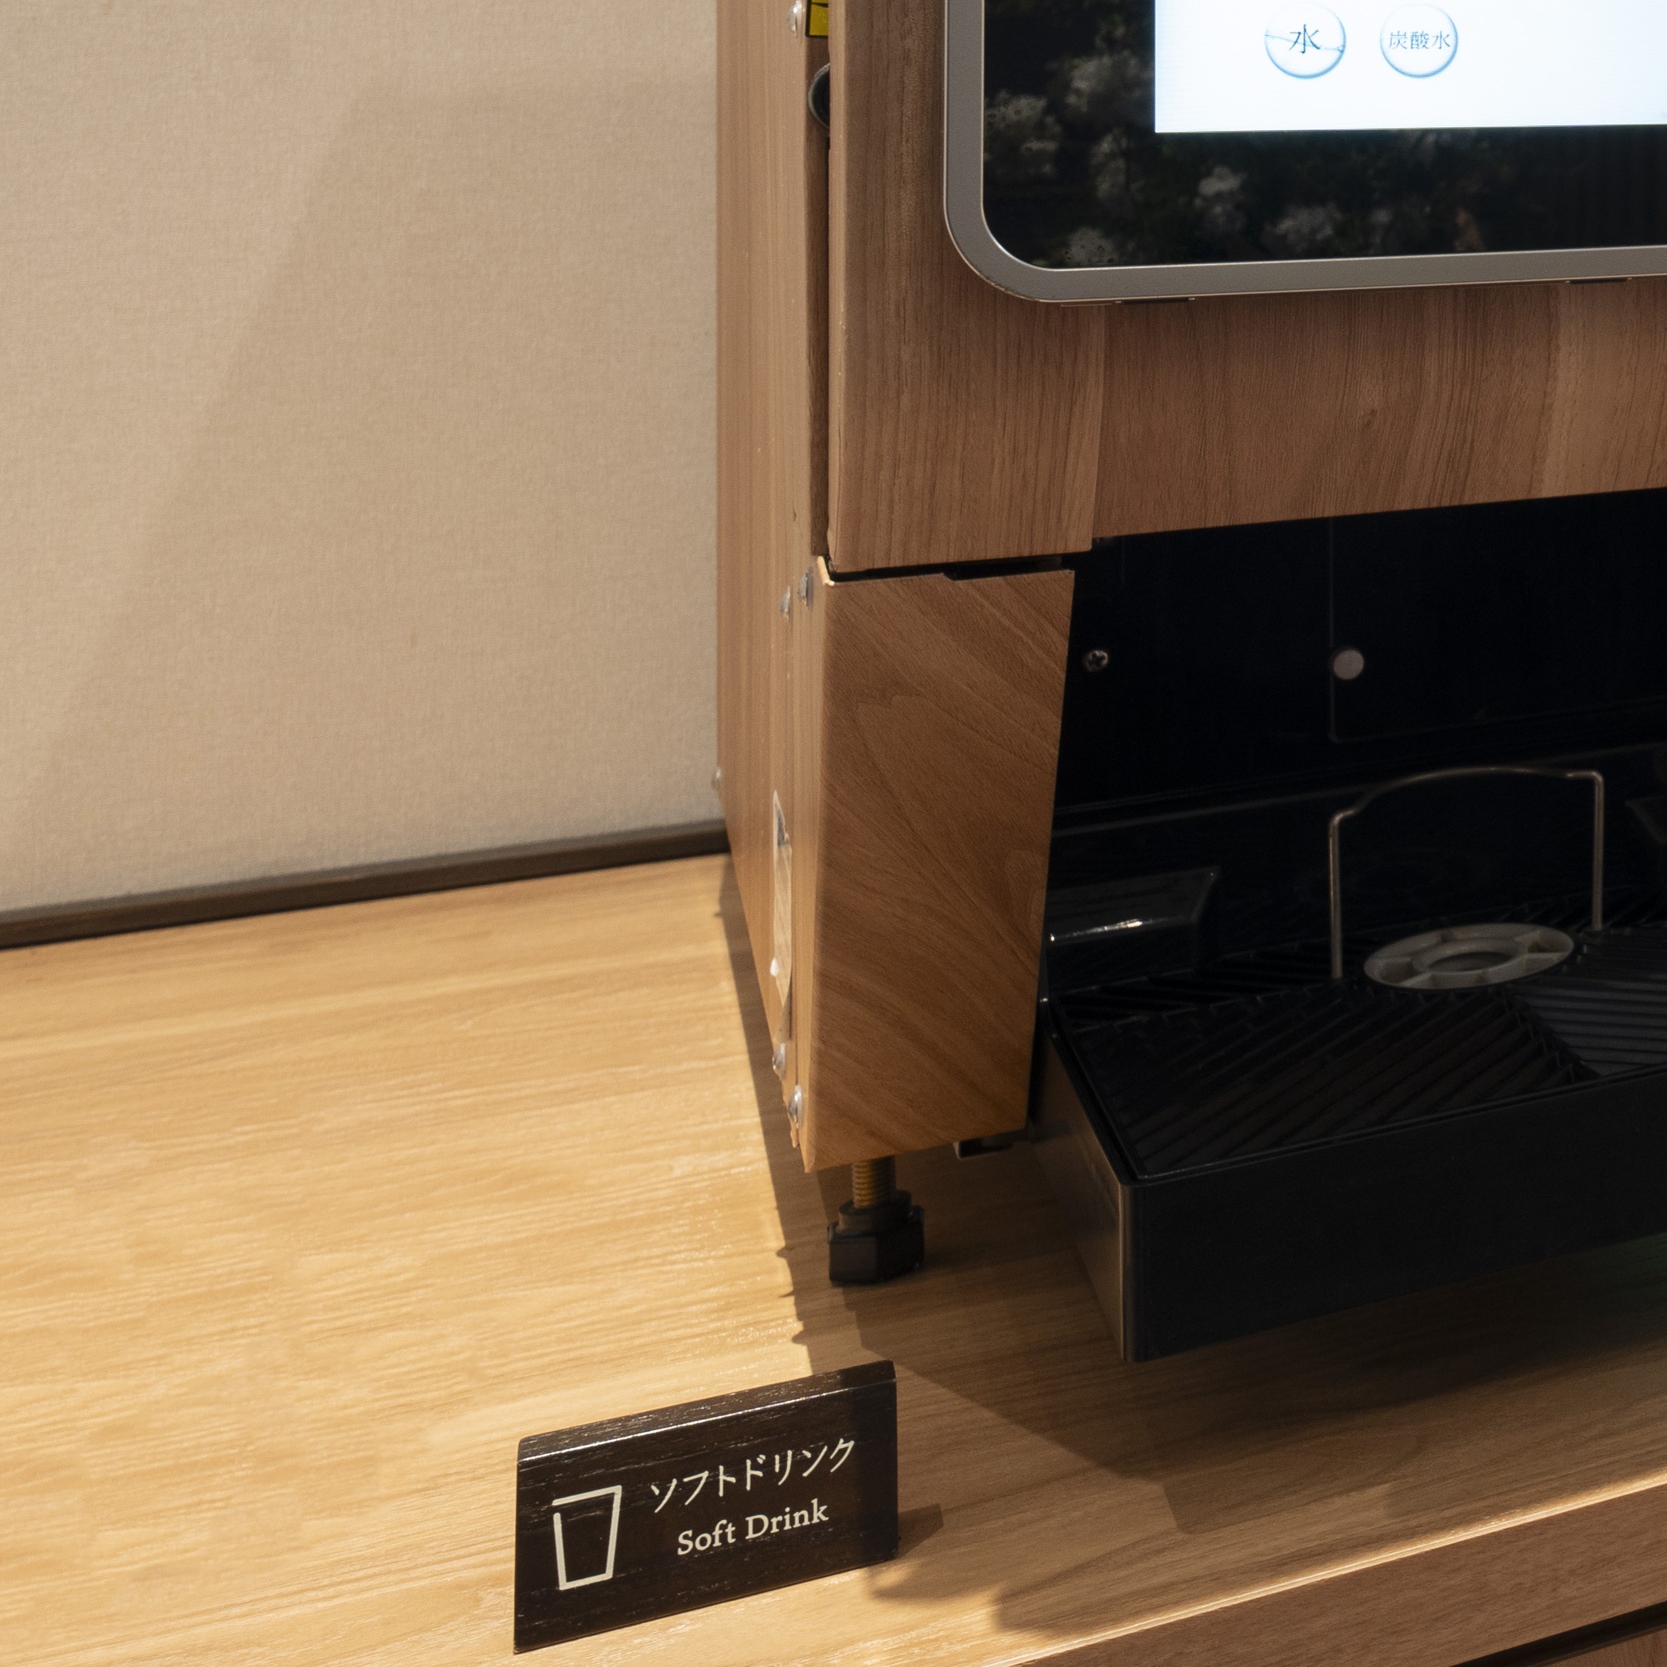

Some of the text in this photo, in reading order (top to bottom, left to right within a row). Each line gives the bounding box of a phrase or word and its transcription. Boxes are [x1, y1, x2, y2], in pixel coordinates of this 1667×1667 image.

[1289, 24, 1321, 54] 水
[1389, 30, 1451, 50] 炭酸水
[650, 1437, 856, 1514] ソフトドリンク
[677, 1498, 829, 1557] Soft Drink
